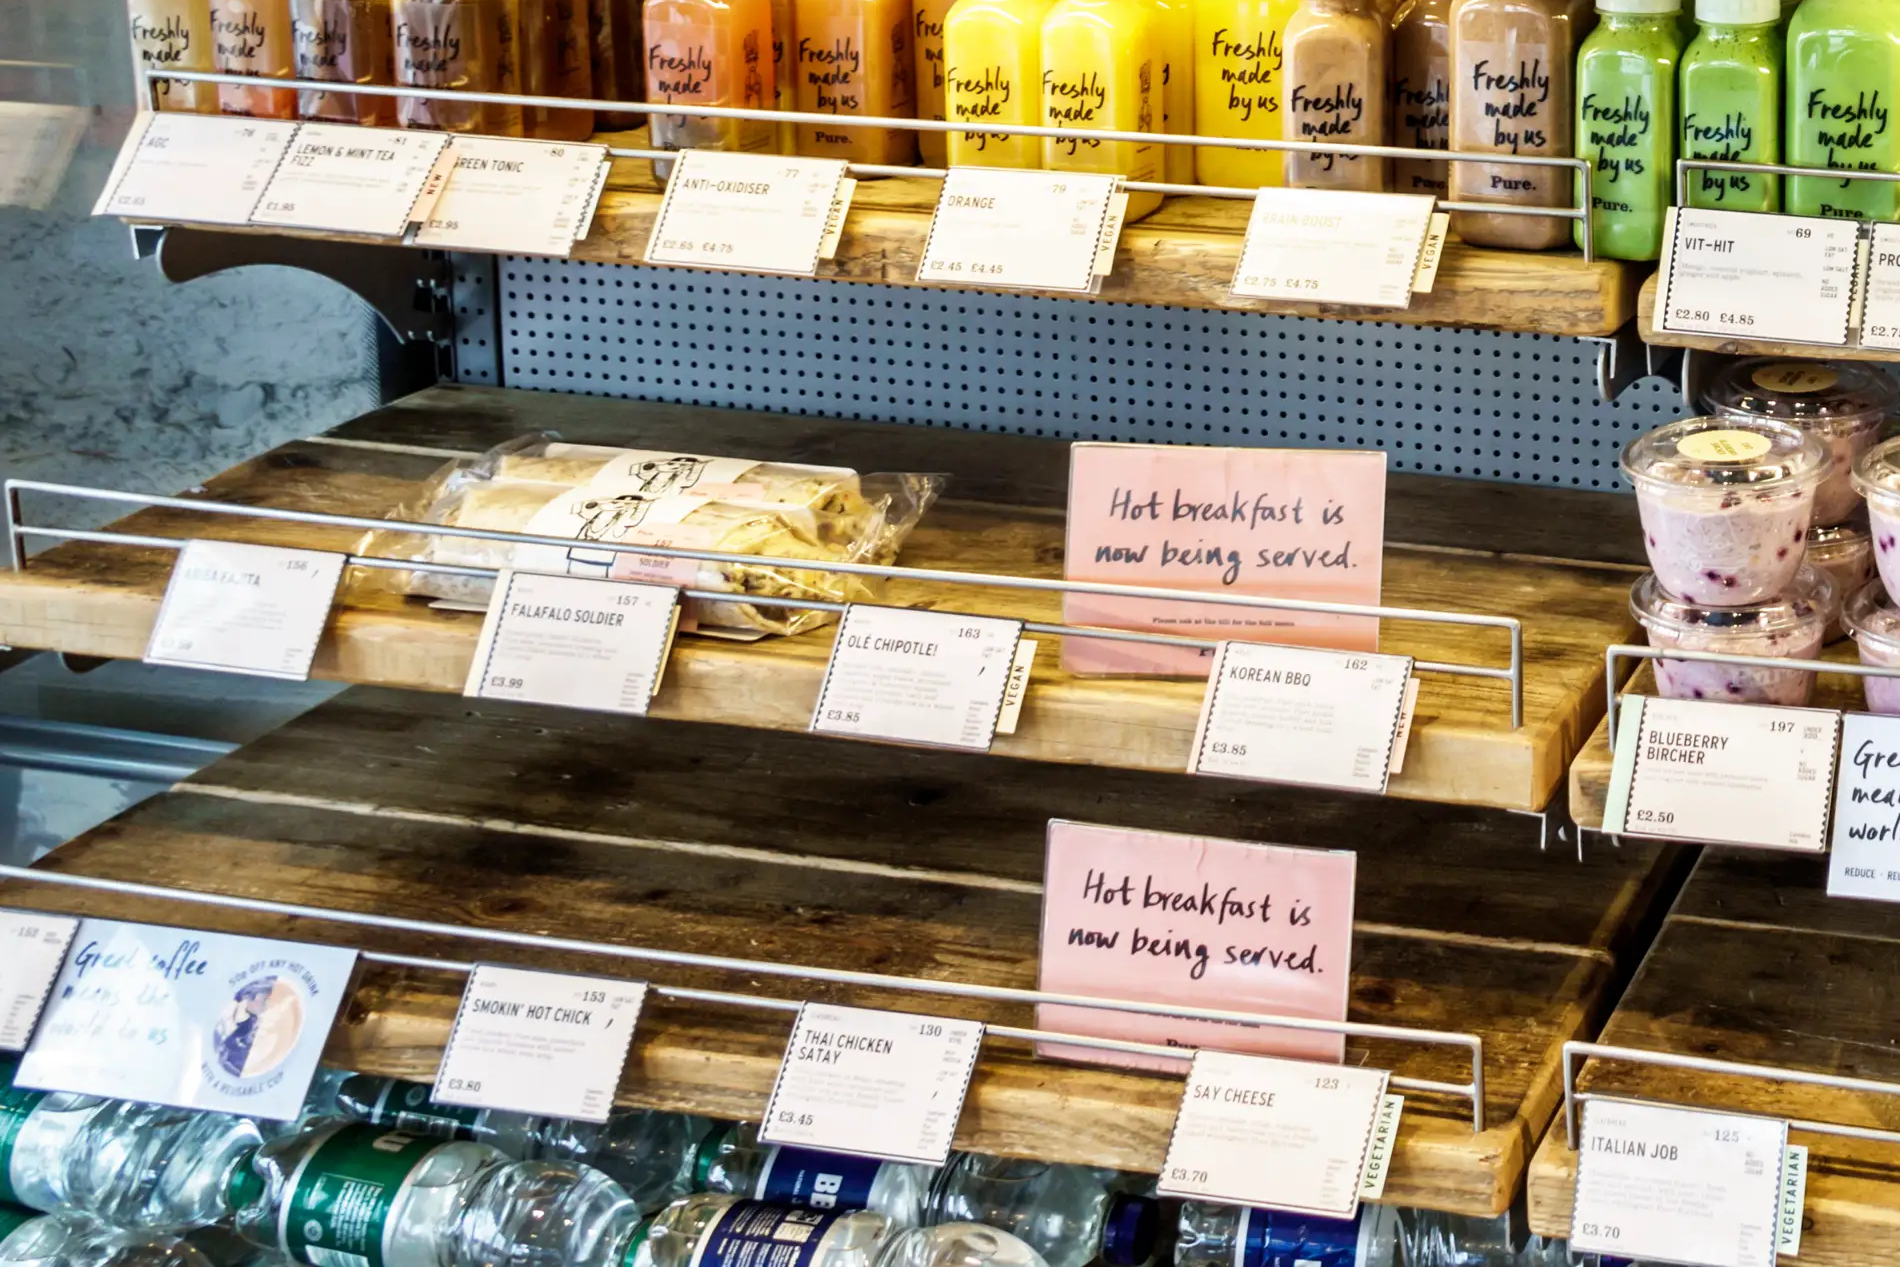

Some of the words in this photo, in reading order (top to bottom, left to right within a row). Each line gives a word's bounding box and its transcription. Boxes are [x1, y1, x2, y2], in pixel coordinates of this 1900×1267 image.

[1473, 58, 1549, 102] Freshly
[1485, 93, 1538, 119] made
[1494, 118, 1518, 154] by
[1524, 129, 1546, 147] us
[297, 144, 333, 155] LEMON
[335, 147, 343, 156] &
[346, 148, 374, 160] MINT
[376, 150, 396, 162] TEA
[682, 178, 771, 196] ANTI-OXIDISER
[1490, 175, 1537, 191] Pure.
[947, 195, 995, 209] ORANGE
[1685, 238, 1735, 253] VIT-HIT
[1675, 309, 1710, 321] £2.80
[1720, 313, 1754, 325] £4.85
[511, 603, 571, 621] FALAFALO
[574, 609, 625, 627] SOLDIER
[847, 634, 870, 649] OLÉ
[874, 637, 938, 657] CHIPOTLE!
[1006, 665, 1024, 707] VEGAN
[1230, 666, 1281, 683] KOREAN
[1285, 671, 1311, 686] BBQ
[1649, 731, 1729, 750] BLUEBERRY
[1647, 746, 1705, 764] BIRCHER
[1845, 867, 1876, 879] REDUCE
[472, 999, 524, 1016] SMOKIN'
[526, 1005, 552, 1020] HOT
[554, 1008, 593, 1025] CHICK
[804, 1030, 835, 1046] THAI
[837, 1035, 894, 1054] CHICKEN
[798, 1047, 841, 1064] SATAY
[1194, 1085, 1221, 1101] SAY
[1224, 1089, 1276, 1107] CHEESE
[1365, 1100, 1395, 1189] VEGETARIAN
[1591, 1136, 1646, 1157] ITALIAN
[1650, 1145, 1678, 1161] JOB
[1781, 1151, 1800, 1245] VEGETARIAN
[1582, 1223, 1620, 1239] £3.70
